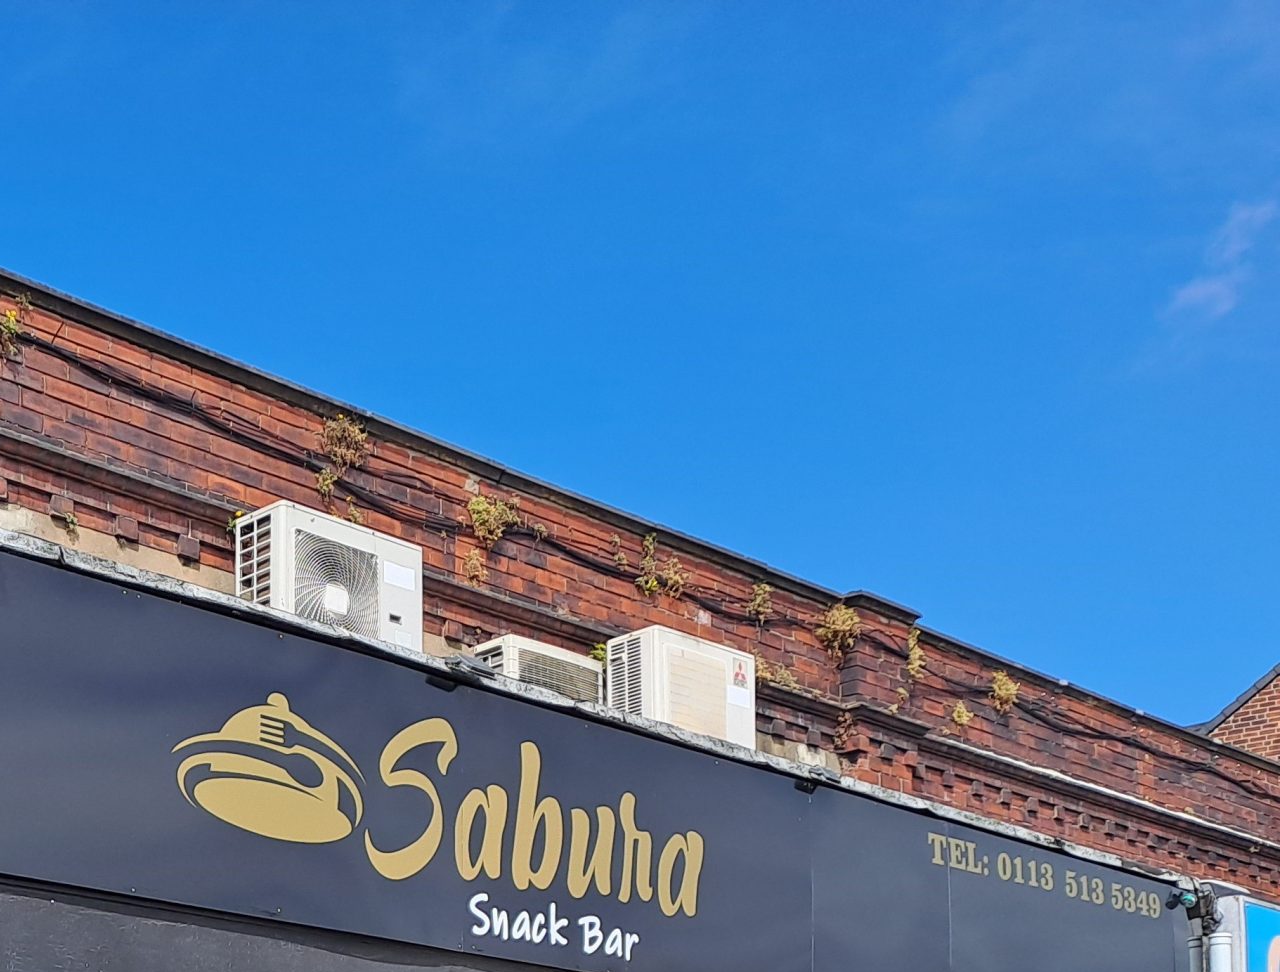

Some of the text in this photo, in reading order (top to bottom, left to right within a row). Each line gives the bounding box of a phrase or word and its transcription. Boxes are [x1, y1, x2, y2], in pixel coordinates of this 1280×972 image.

[364, 717, 705, 918] Sabura
[927, 832, 1161, 919] TEL: 0113 513 5349
[468, 893, 640, 962] Snack Bar
